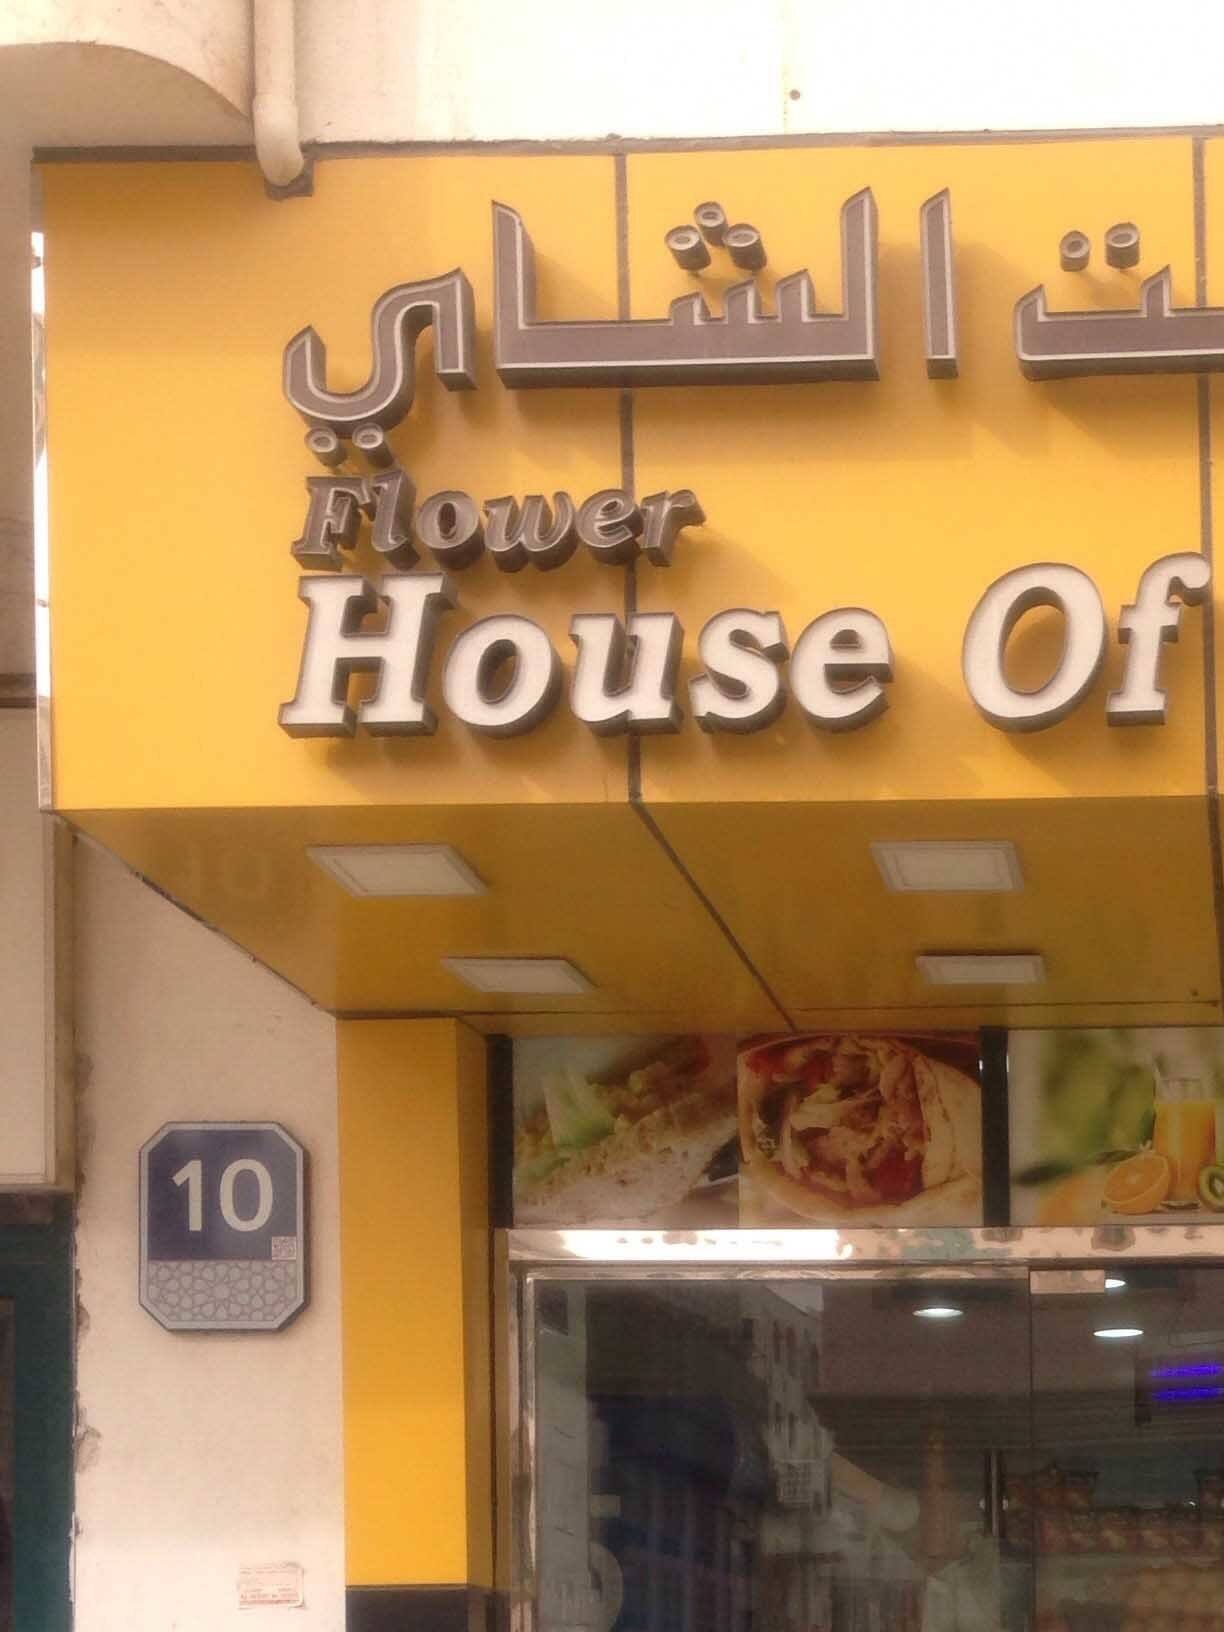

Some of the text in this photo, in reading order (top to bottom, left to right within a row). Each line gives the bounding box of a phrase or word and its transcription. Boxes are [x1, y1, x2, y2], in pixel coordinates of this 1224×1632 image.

[282, 186, 960, 468] الشاي
[290, 466, 707, 572] Flower
[277, 570, 895, 740] House
[960, 551, 1212, 734] Of
[171, 1157, 274, 1233] 10
